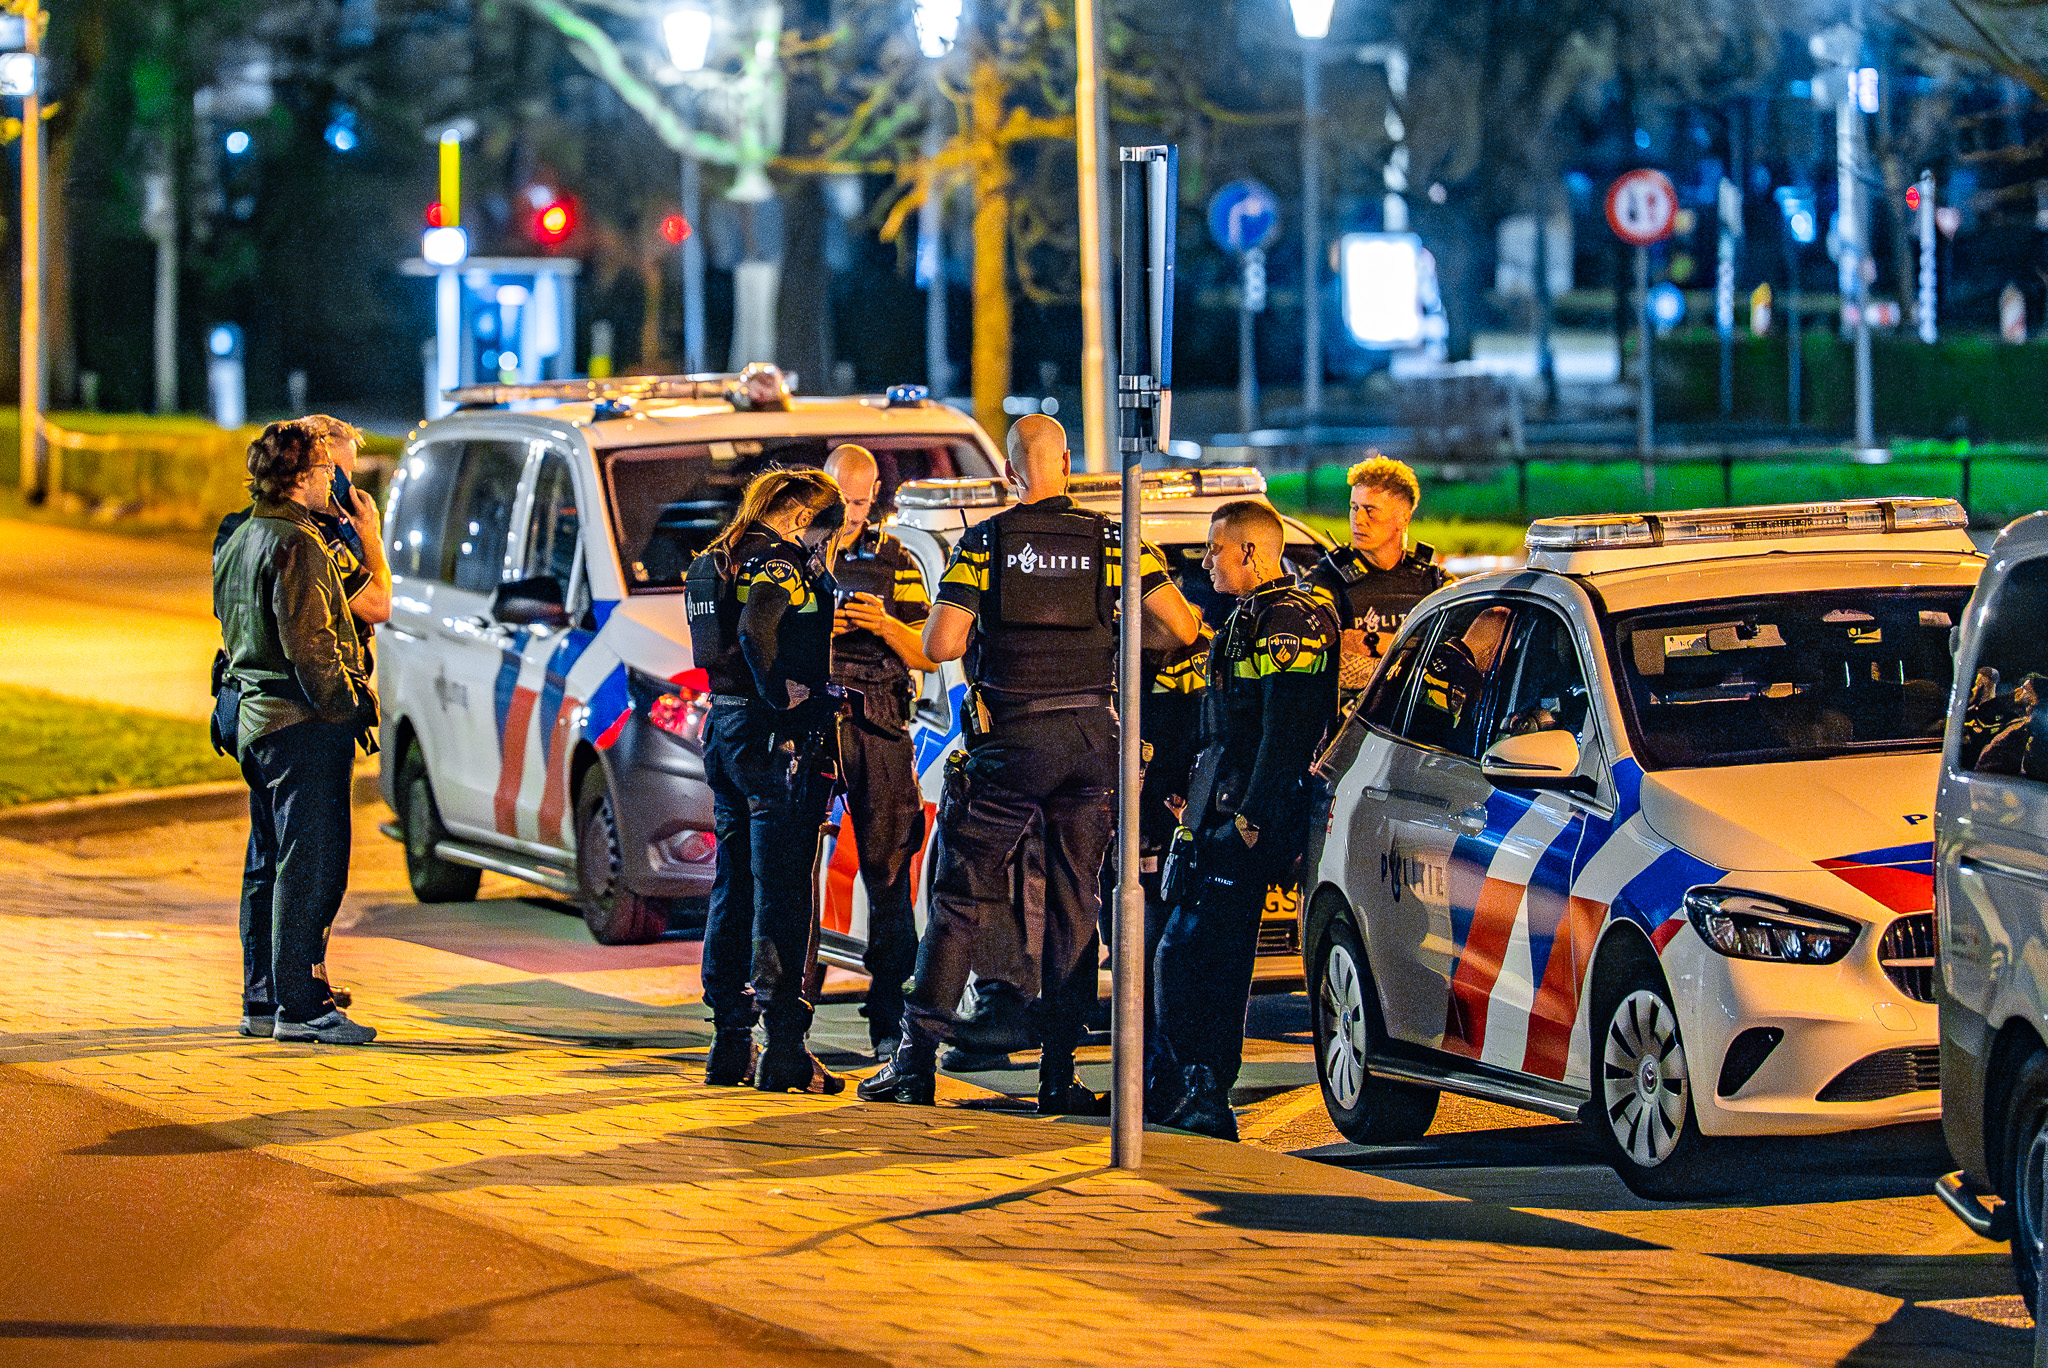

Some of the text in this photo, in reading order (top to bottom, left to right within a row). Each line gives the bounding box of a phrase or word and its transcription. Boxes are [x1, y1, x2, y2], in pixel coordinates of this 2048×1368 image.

[1007, 543, 1090, 574] POLITIE
[687, 591, 716, 623] OLITIE
[1354, 606, 1407, 633] POLIT
